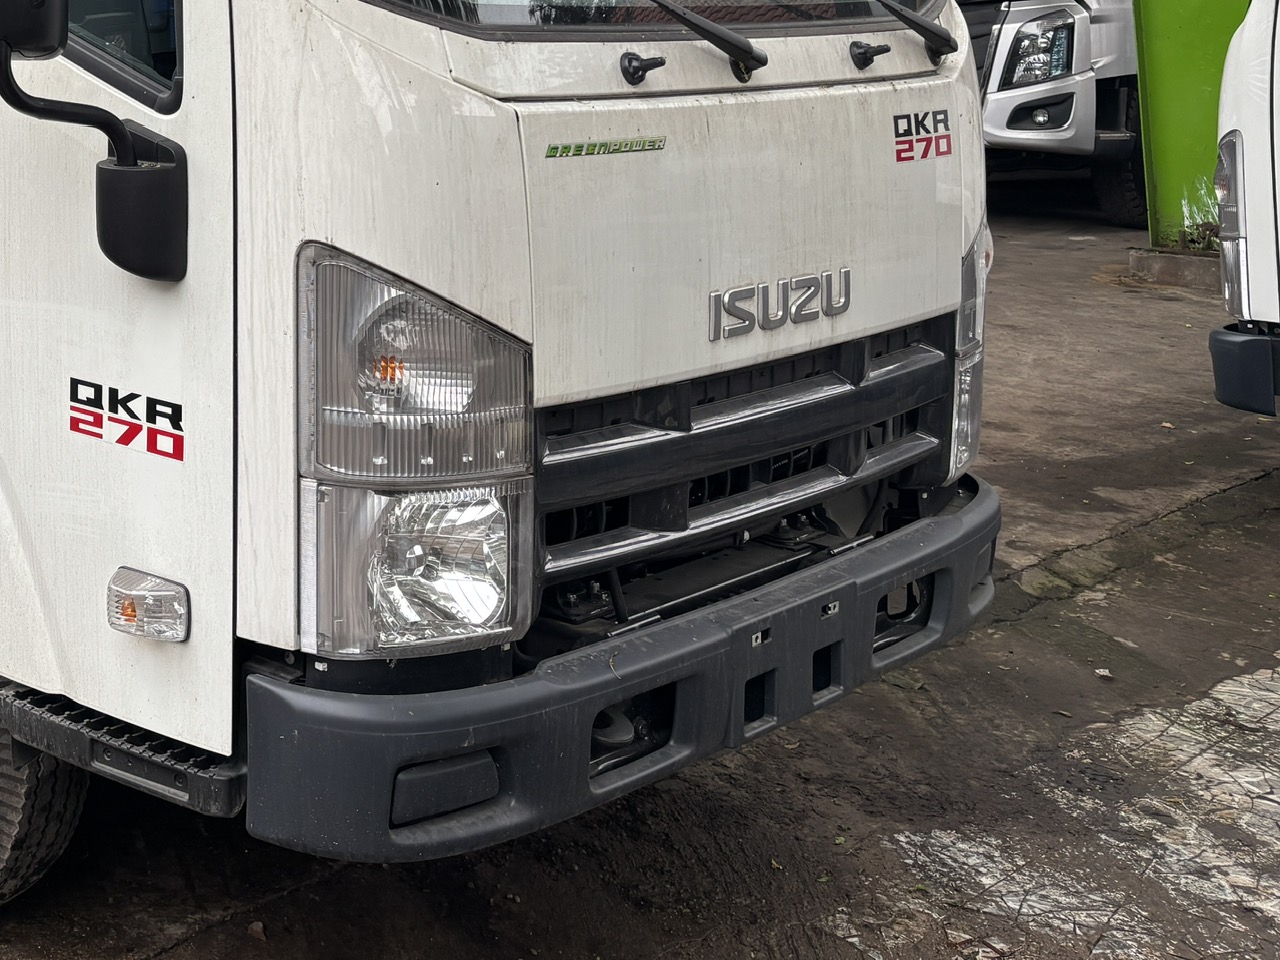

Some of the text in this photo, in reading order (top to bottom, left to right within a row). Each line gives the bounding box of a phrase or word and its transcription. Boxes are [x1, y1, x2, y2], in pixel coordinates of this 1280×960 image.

[893, 109, 951, 139] QKR
[546, 136, 666, 158] GREENPOWER
[895, 134, 953, 163] 270
[709, 266, 851, 342] ISUZU
[69, 376, 185, 433] QKR
[69, 404, 185, 462] 270
